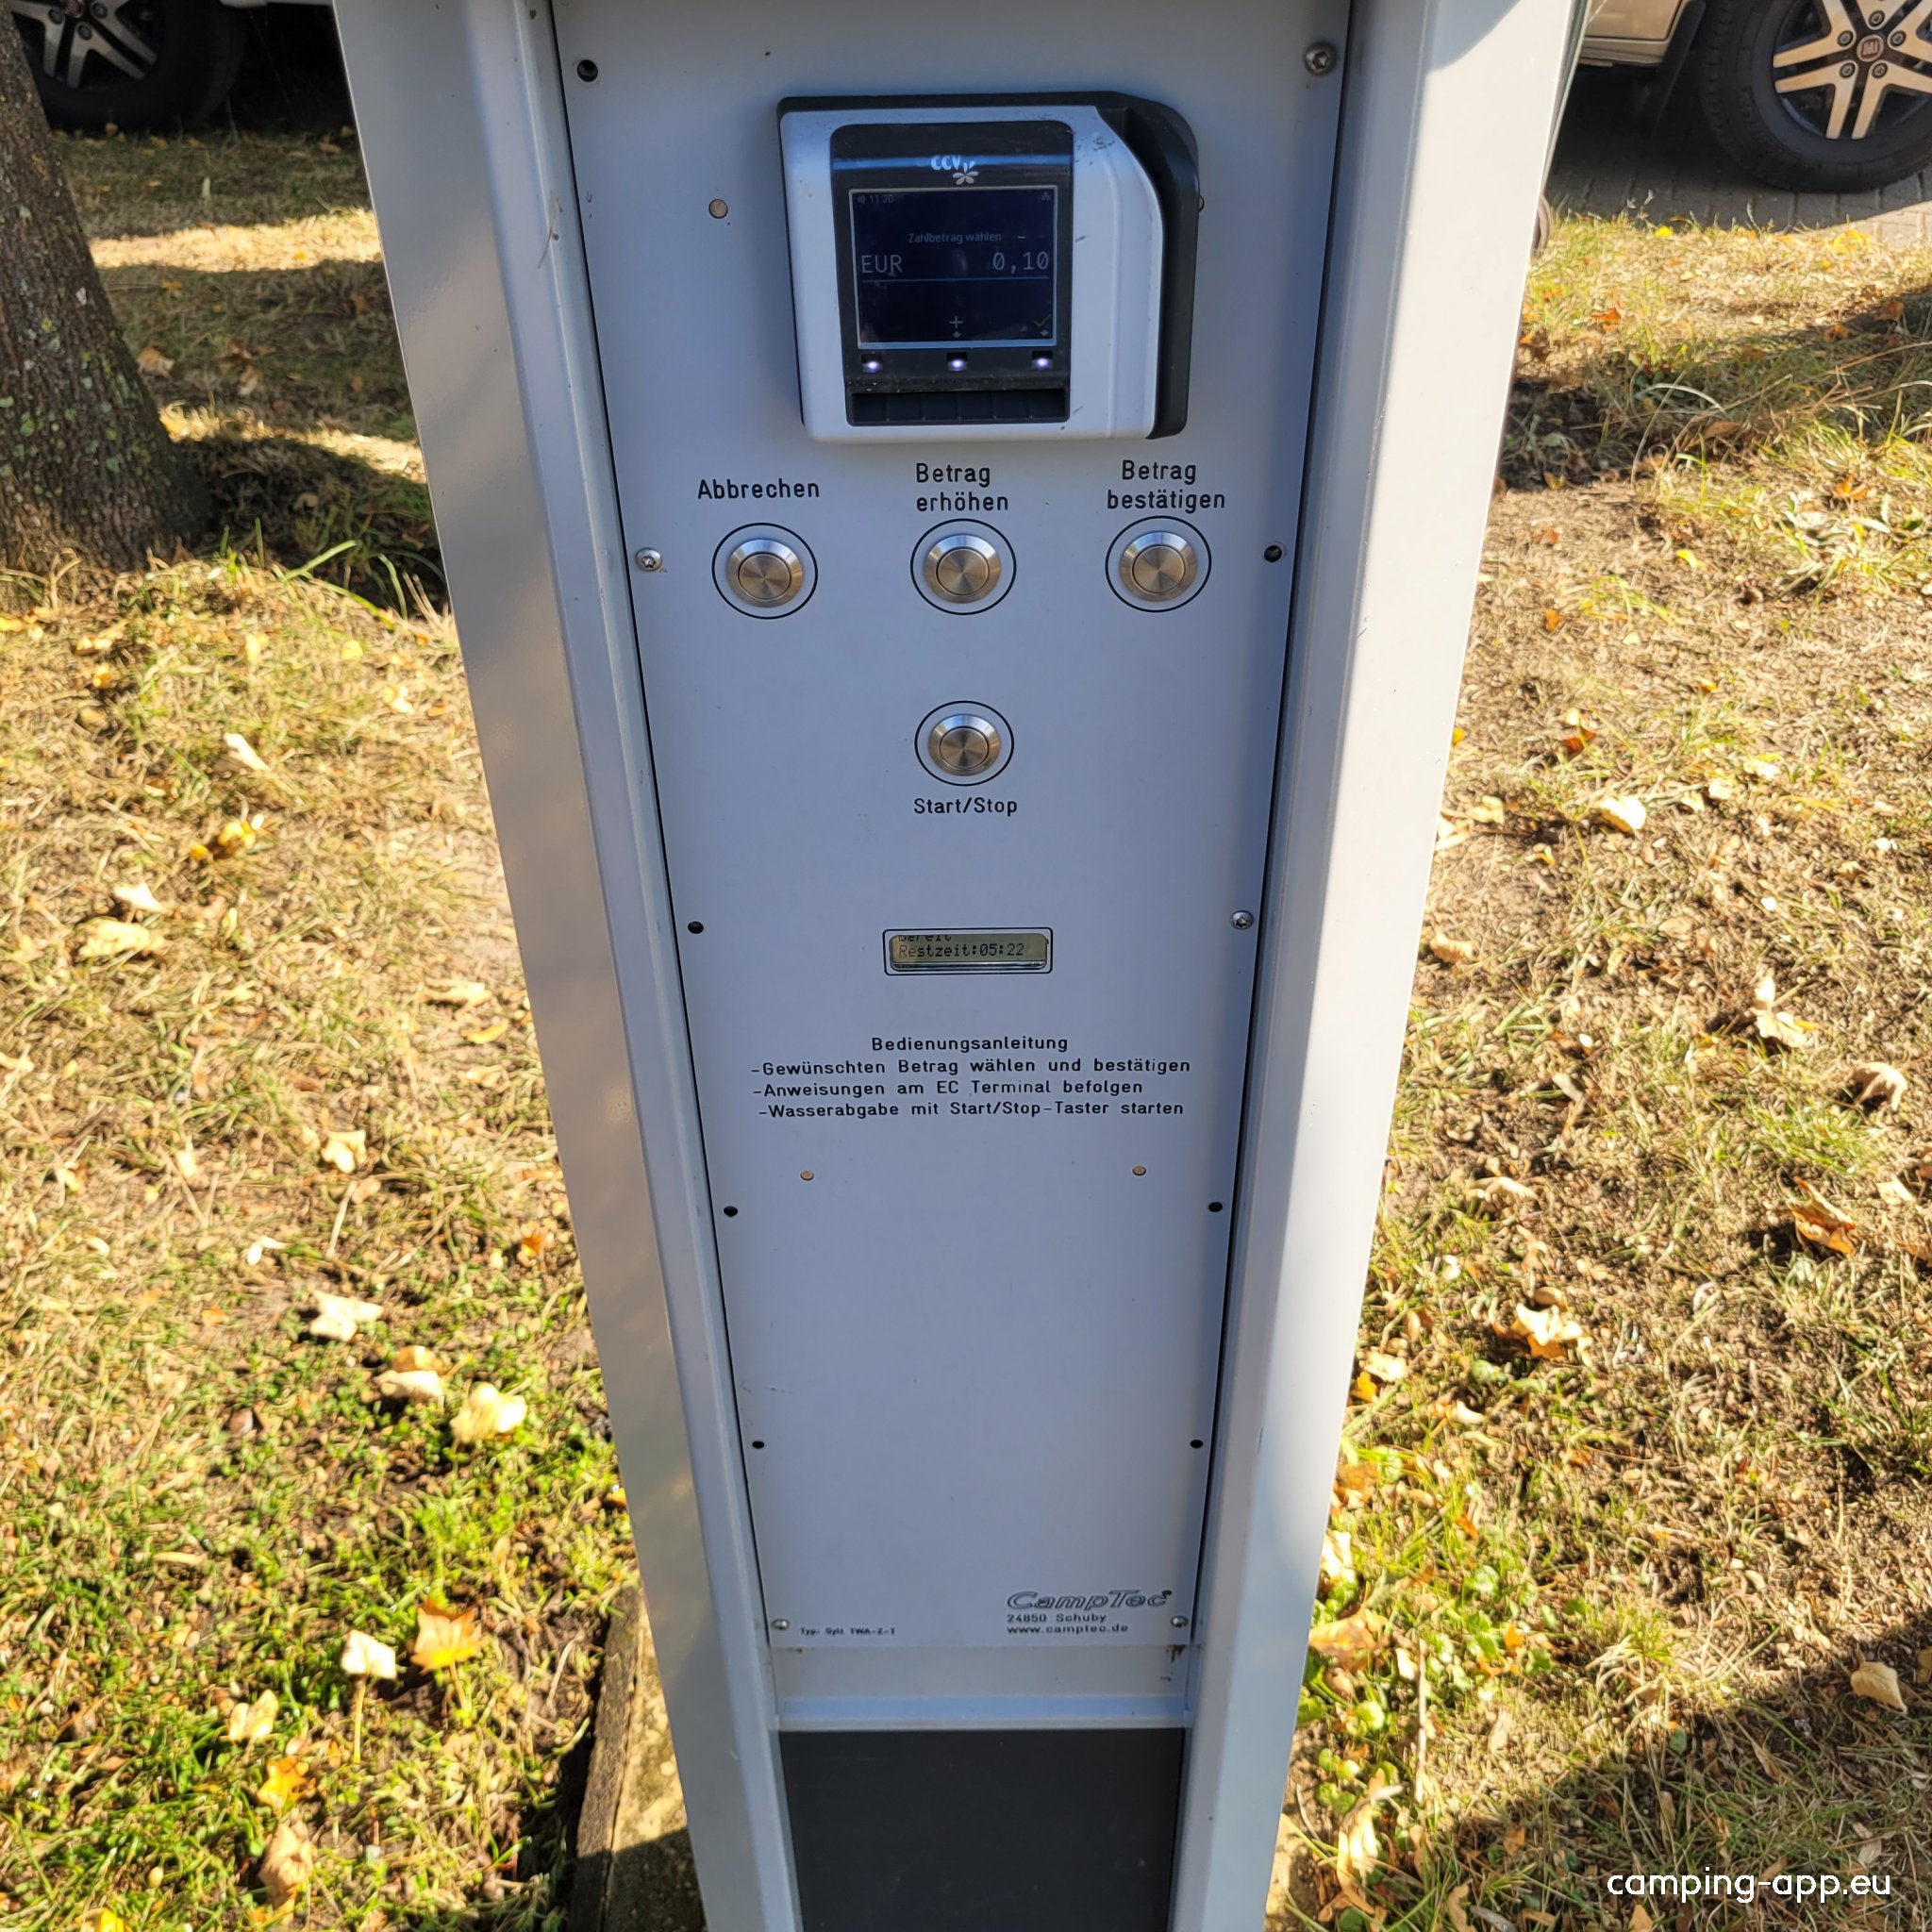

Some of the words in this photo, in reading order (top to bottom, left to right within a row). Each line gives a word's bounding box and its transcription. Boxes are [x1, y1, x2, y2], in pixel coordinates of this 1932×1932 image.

[930, 155, 962, 172] CCV
[908, 232, 963, 244] Zahlbetrag
[861, 254, 904, 275] EUR
[992, 251, 1049, 275] 0,10
[916, 462, 991, 485] Betrag
[1122, 459, 1197, 486] Betrag
[697, 477, 820, 500] Abbrechen
[1107, 485, 1225, 511] bestätigen
[916, 491, 1008, 512] erhöhen
[913, 796, 1018, 817] Start/Stop
[899, 943, 1024, 958] Restzeit:05:22
[872, 1035, 1068, 1054] Bedienungsanleitung
[751, 1060, 886, 1075] -Gewünschten
[898, 1059, 958, 1076] Betrag
[969, 1058, 1036, 1073] wählen
[1048, 1058, 1081, 1072] und
[1093, 1058, 1191, 1075] bestätigen
[753, 1082, 885, 1099] -Anweisungen
[897, 1084, 924, 1094] am
[937, 1080, 959, 1094] EC
[971, 1079, 1051, 1093] Terminal
[1063, 1079, 1142, 1097] befolgen
[758, 1102, 899, 1120] -Wasserabgabe
[911, 1102, 939, 1115] mit
[950, 1100, 1109, 1118] Start/Stop-Taster
[1121, 1102, 1184, 1115] starten
[1007, 1590, 1173, 1611] CampTec
[1007, 1614, 1047, 1623] 24850
[1056, 1612, 1108, 1624] Schuby
[1007, 1623, 1129, 1634] www.camptec.de
